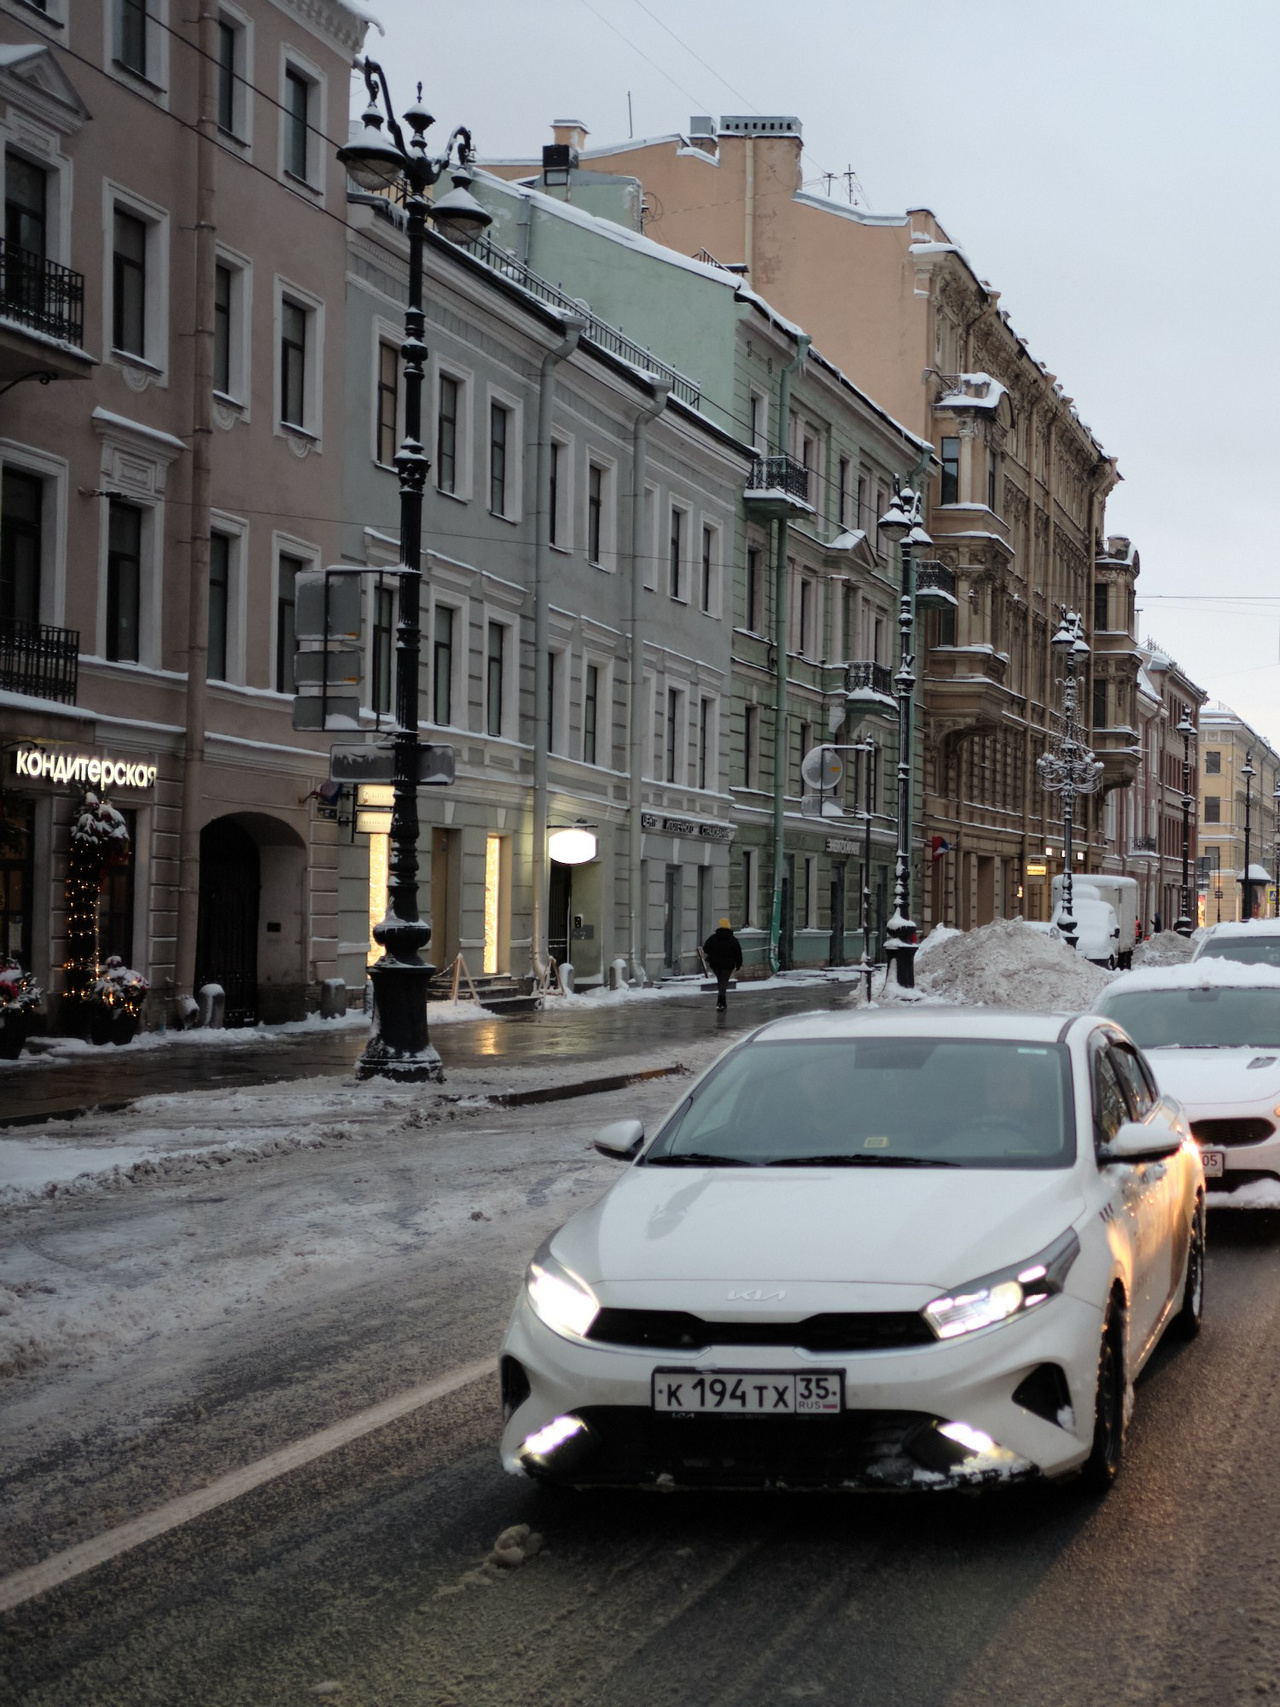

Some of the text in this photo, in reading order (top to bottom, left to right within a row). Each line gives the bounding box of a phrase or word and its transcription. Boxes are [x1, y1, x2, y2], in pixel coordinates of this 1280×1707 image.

[16, 748, 157, 791] кондитерская
[727, 1290, 786, 1302] KIA
[799, 1377, 831, 1401] 35
[799, 1401, 822, 1409] RUS
